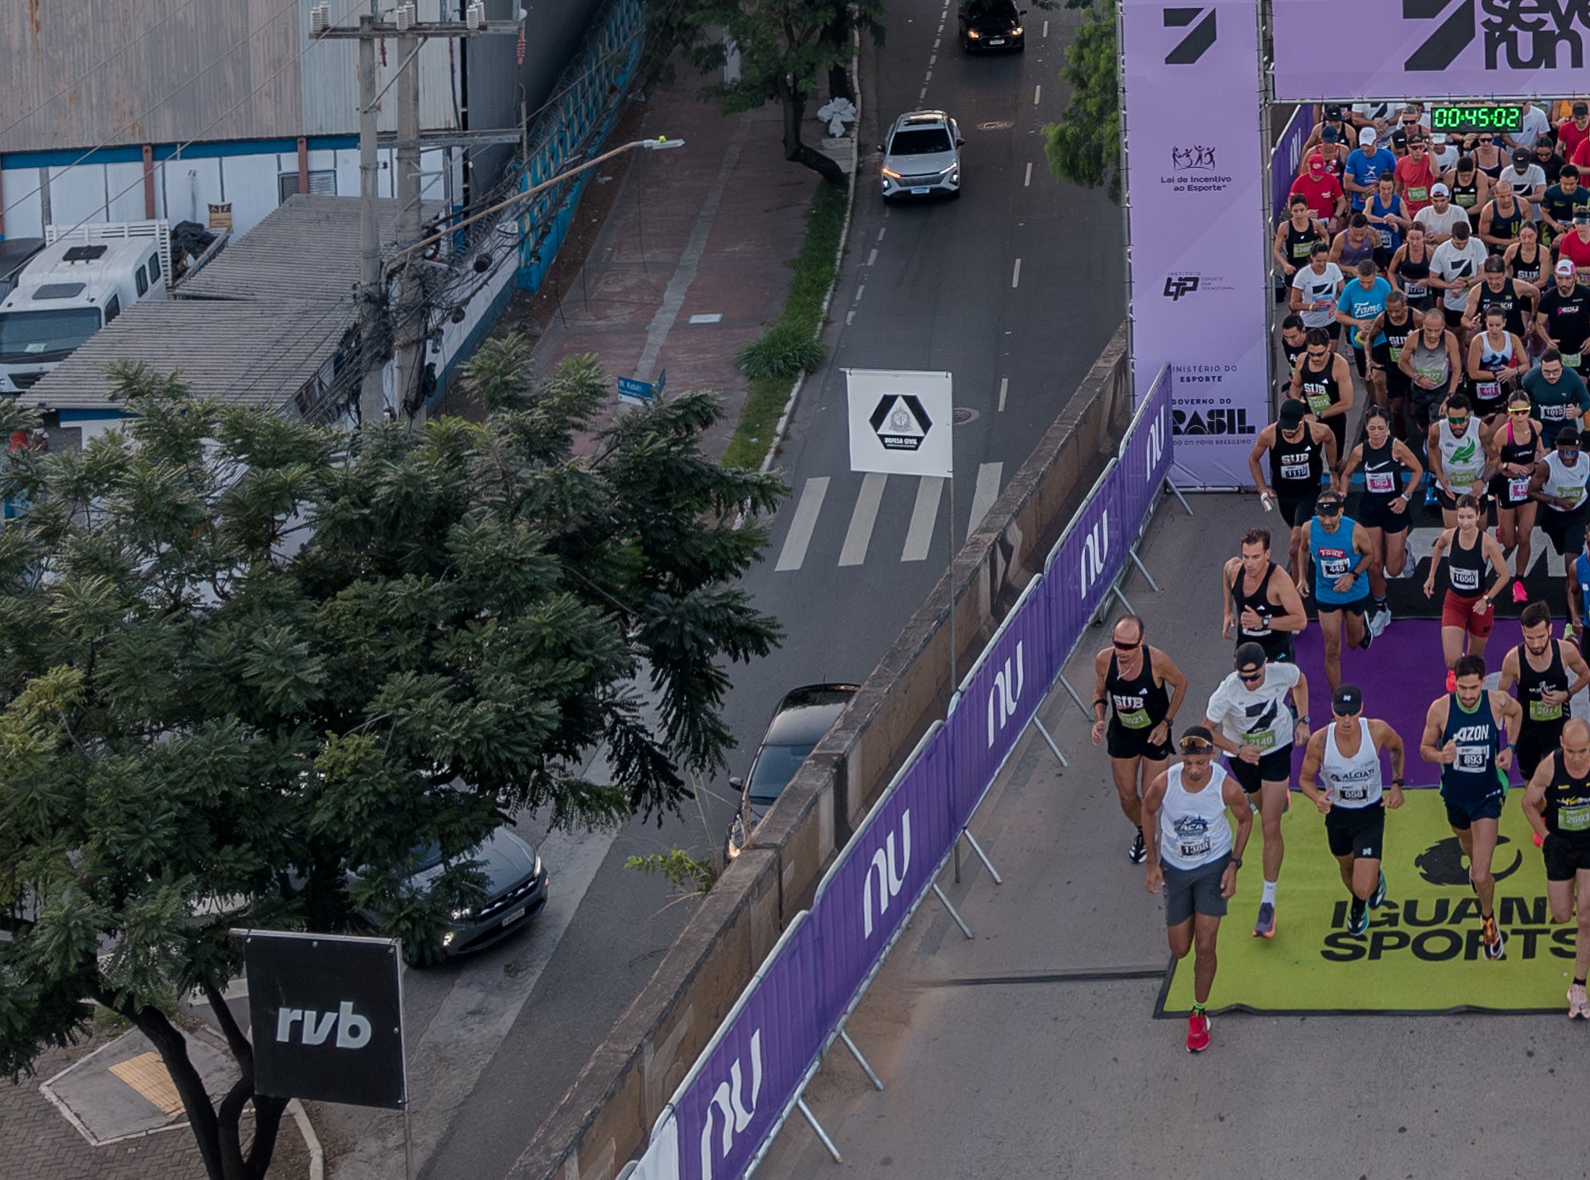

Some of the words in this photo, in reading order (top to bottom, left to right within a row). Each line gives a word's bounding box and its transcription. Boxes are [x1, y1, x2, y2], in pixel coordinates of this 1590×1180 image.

[1483, 28, 1584, 71] run
[1434, 107, 1520, 128] 00:45:02
[1190, 175, 1232, 184] Incentivo
[1180, 375, 1223, 383] ESPORTE
[1303, 382, 1327, 395] SUB
[1146, 403, 1166, 484] nu
[1280, 453, 1309, 465] SUB
[1079, 510, 1110, 601] nu
[986, 640, 1025, 749] nu
[1113, 694, 1144, 710] SUB
[1463, 753, 1483, 766] 893
[863, 809, 912, 939] nu
[276, 1000, 372, 1050] rvb
[700, 1028, 762, 1180] nu
